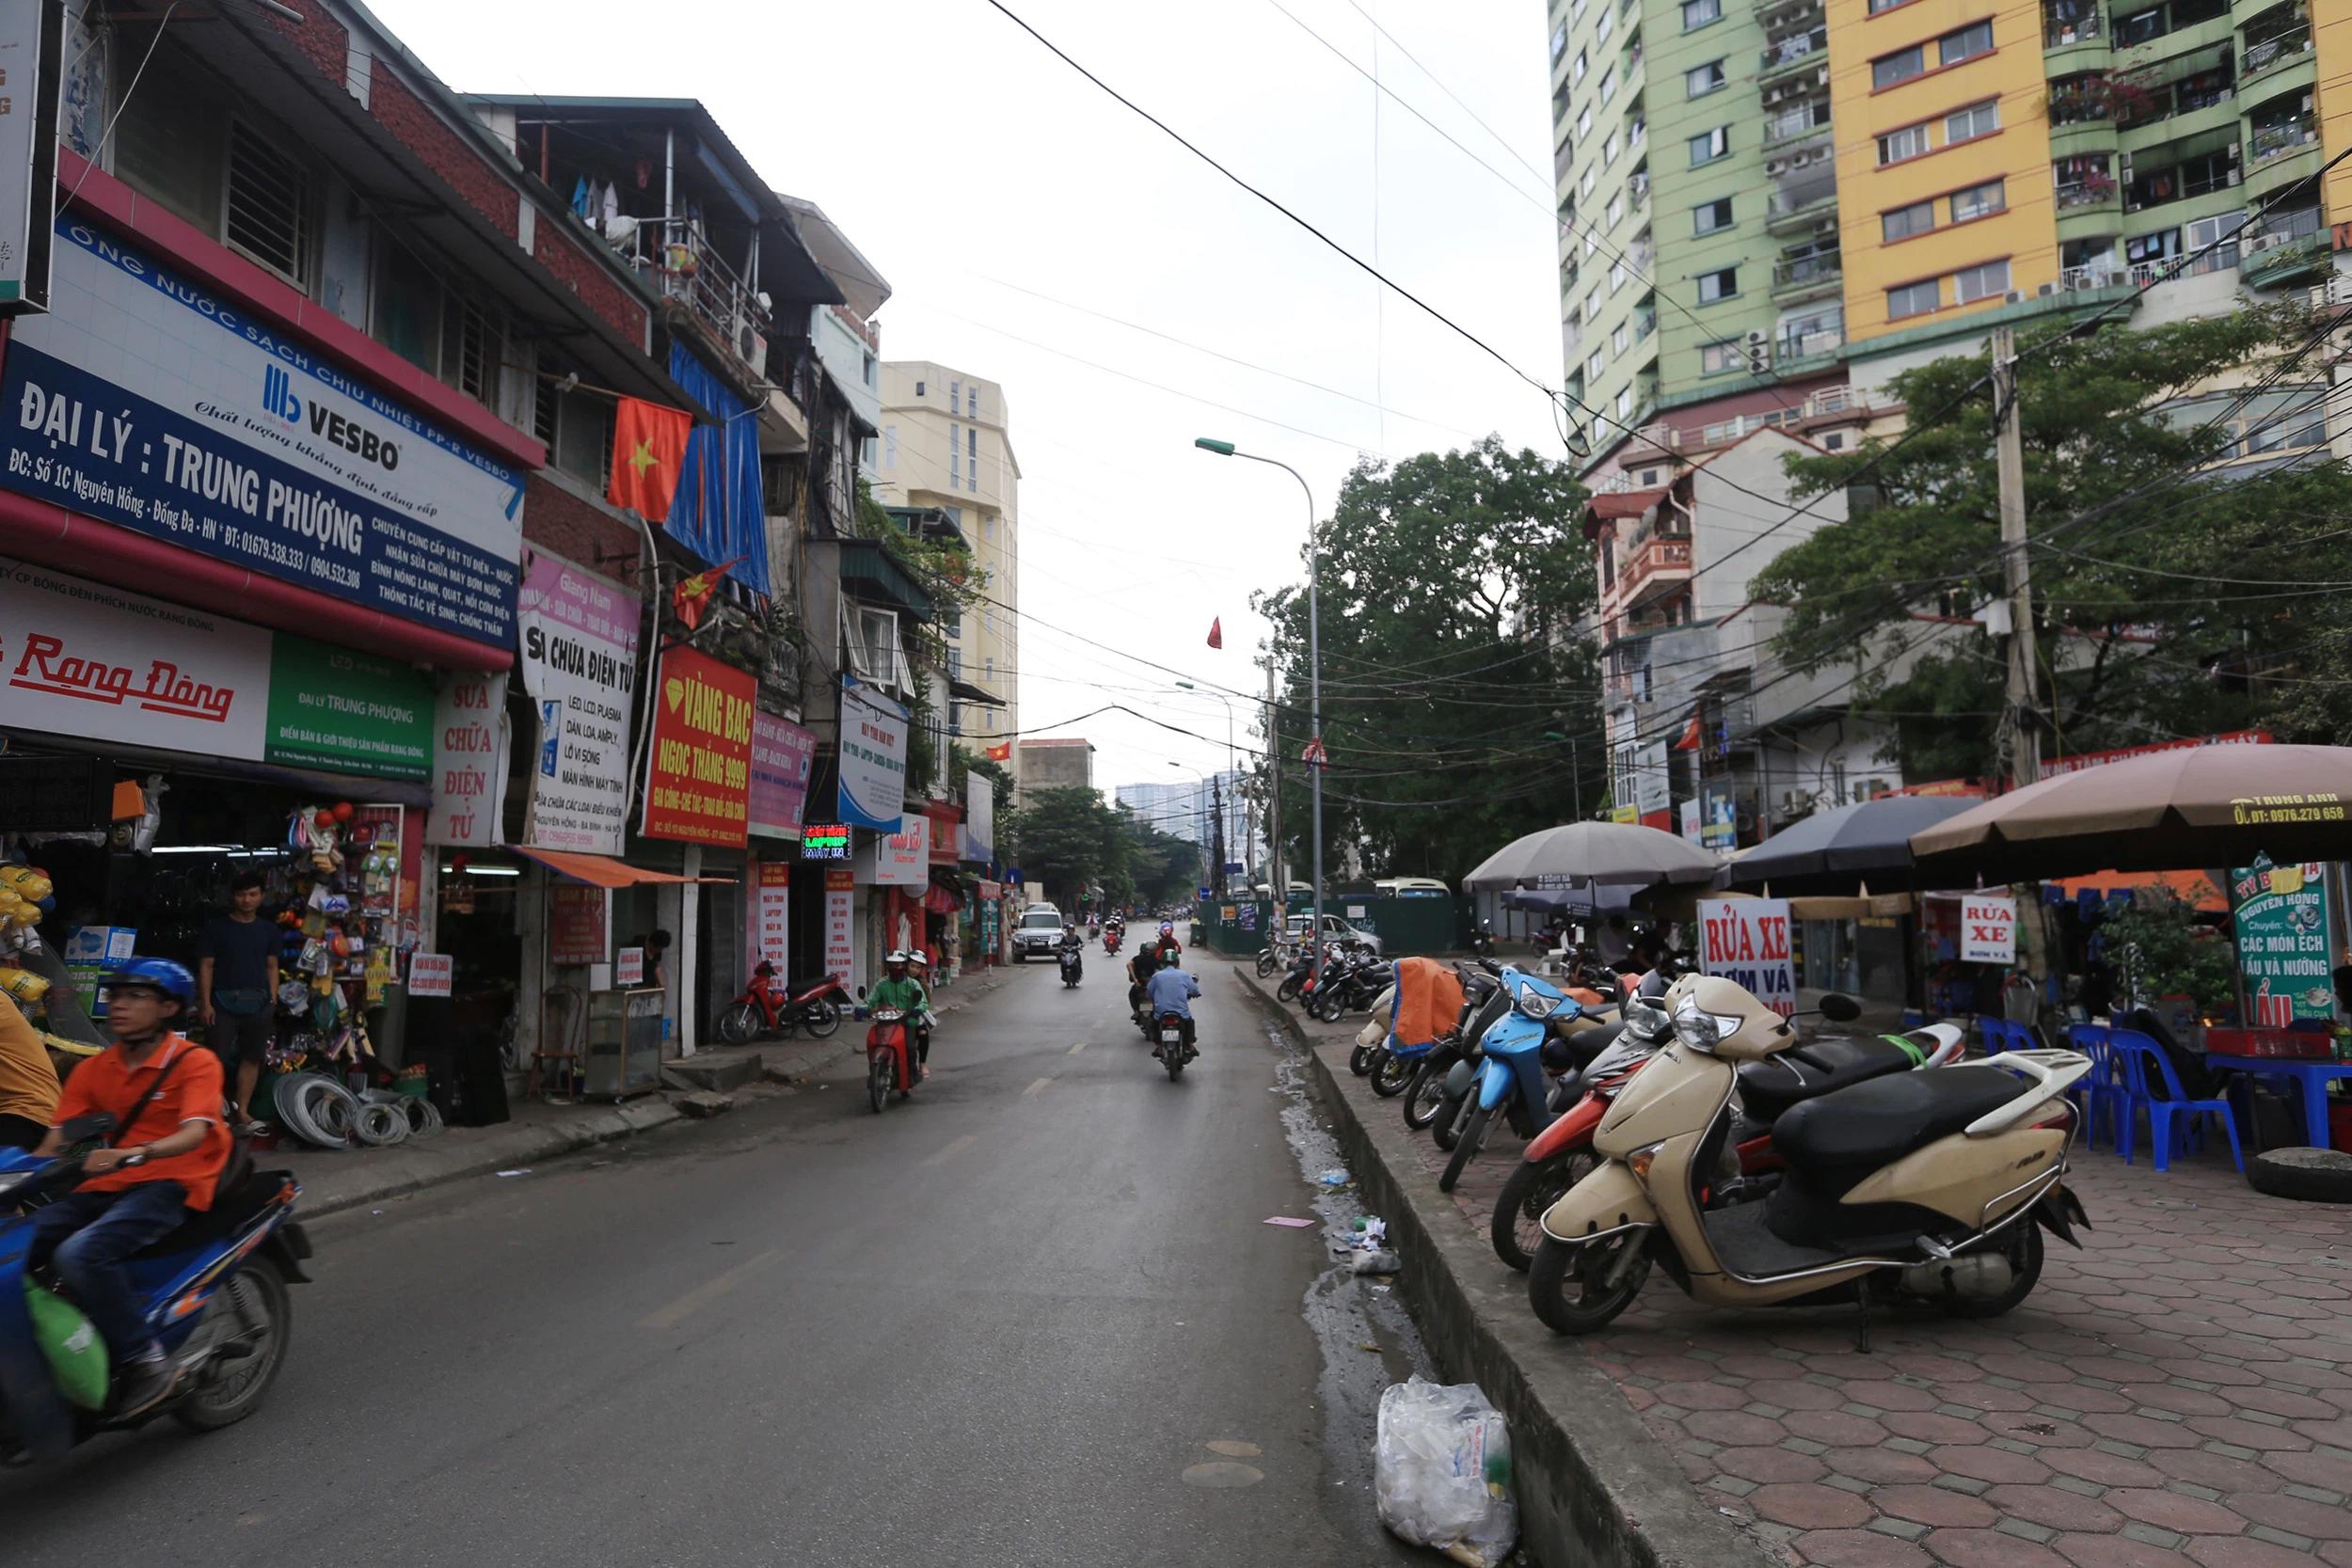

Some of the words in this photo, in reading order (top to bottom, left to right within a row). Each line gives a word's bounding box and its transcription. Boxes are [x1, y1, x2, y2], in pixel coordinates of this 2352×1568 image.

[70, 225, 145, 275] ỐNG
[156, 273, 236, 328] NƯỚC
[246, 325, 309, 369] SẠCH
[316, 367, 365, 401] CHỊU
[372, 398, 421, 433] NHIỆT
[427, 428, 461, 453] PP-R
[466, 450, 510, 481] VESBO
[309, 400, 399, 470] VESBO
[21, 381, 83, 450] ĐẠI
[91, 408, 134, 465] LÝ
[164, 434, 260, 516] TRUNG
[266, 479, 363, 556] PHƯỢNG
[195, 402, 239, 424] Chất
[245, 418, 291, 447] lượng
[347, 471, 378, 494] định
[417, 502, 437, 517] cấp
[8, 448, 32, 477] ĐC:
[35, 456, 55, 483] Số
[55, 464, 72, 489] 1C
[73, 469, 114, 506] Nguyên
[117, 485, 145, 519] Hồng
[153, 499, 180, 531] Đống
[182, 509, 194, 533] Đa
[202, 517, 217, 541] HN
[225, 525, 240, 548] ĐT:
[242, 532, 303, 571] 01679.338.333
[310, 556, 360, 590] 0904.532.308
[372, 517, 406, 541] CHUYÊN
[407, 531, 429, 549] CUNG
[430, 538, 446, 557] CẤP
[472, 559, 490, 575] ĐIỆN
[496, 567, 514, 585] NƯỚC
[15, 572, 31, 584] CP
[69, 585, 92, 601] ĐÈN
[93, 592, 126, 610] PHÍCH
[371, 560, 392, 578] BÌNH
[393, 568, 416, 587] NÓNG
[418, 577, 440, 596] LẠNH,
[442, 586, 464, 605] QUẠT,
[478, 601, 494, 615] CƠM
[495, 605, 511, 622] ĐIỆN
[386, 544, 408, 563] NHẬN
[428, 561, 452, 579] CHỮA
[450, 568, 467, 585] MÁY
[467, 576, 483, 591] BƠM
[484, 582, 502, 600] NƯỚC
[560, 574, 589, 604] Giang
[590, 586, 611, 610] Nam
[379, 585, 407, 606] THÔNG
[408, 593, 424, 612] TẮC
[426, 600, 437, 617] VỆ
[459, 611, 483, 631] CHỐNG
[484, 620, 503, 638] THẤM
[8, 632, 133, 705] Rạng
[140, 659, 234, 722] Đông
[298, 692, 314, 707] ĐẠI
[327, 694, 366, 716] TRUNG
[368, 703, 414, 724] PHƯỢNG
[596, 705, 623, 723] PLASMA
[684, 672, 723, 736] VÀNG
[724, 694, 752, 752] BẠC
[444, 721, 492, 752] CHỮA
[444, 763, 486, 802] ĐIỆN
[659, 737, 691, 783] NGỌC
[724, 756, 746, 791] 9999
[2252, 795, 2303, 805] TRUNG
[2308, 793, 2339, 803] ANH
[2270, 807, 2321, 822] 0976.279
[2323, 806, 2344, 819] 658
[449, 805, 475, 840] TỬ
[805, 836, 847, 847] LAPTOP
[1966, 902, 2012, 922] RỬA
[2248, 919, 2283, 931] Chuyên:
[1706, 903, 1756, 963] RỬA
[1757, 917, 1789, 961] XE
[1971, 926, 2008, 943] XE
[2240, 934, 2264, 953] CÁC
[2267, 934, 2296, 953] MÓN
[1763, 964, 1791, 993] VÁ
[2240, 954, 2262, 976] ẨU
[2265, 958, 2280, 975] VÀ
[2283, 958, 2328, 976] NƯỚNG
